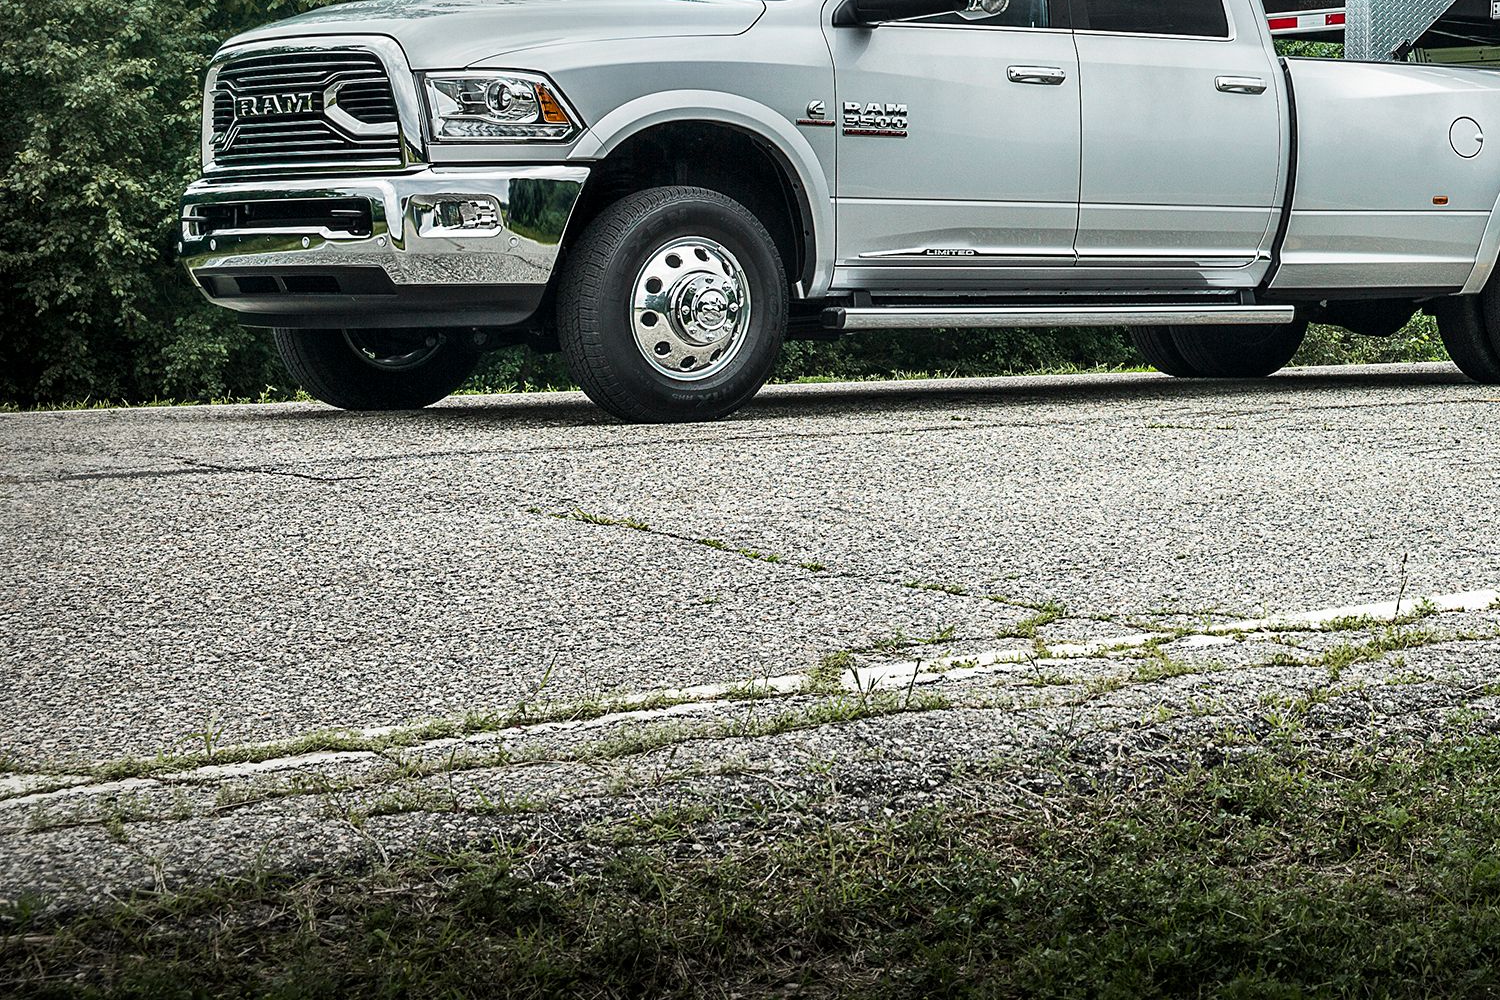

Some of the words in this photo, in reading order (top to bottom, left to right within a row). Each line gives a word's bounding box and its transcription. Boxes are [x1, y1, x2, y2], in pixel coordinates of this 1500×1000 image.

[237, 92, 314, 117] RAM
[842, 101, 908, 117] RAM
[842, 115, 908, 129] 3500
